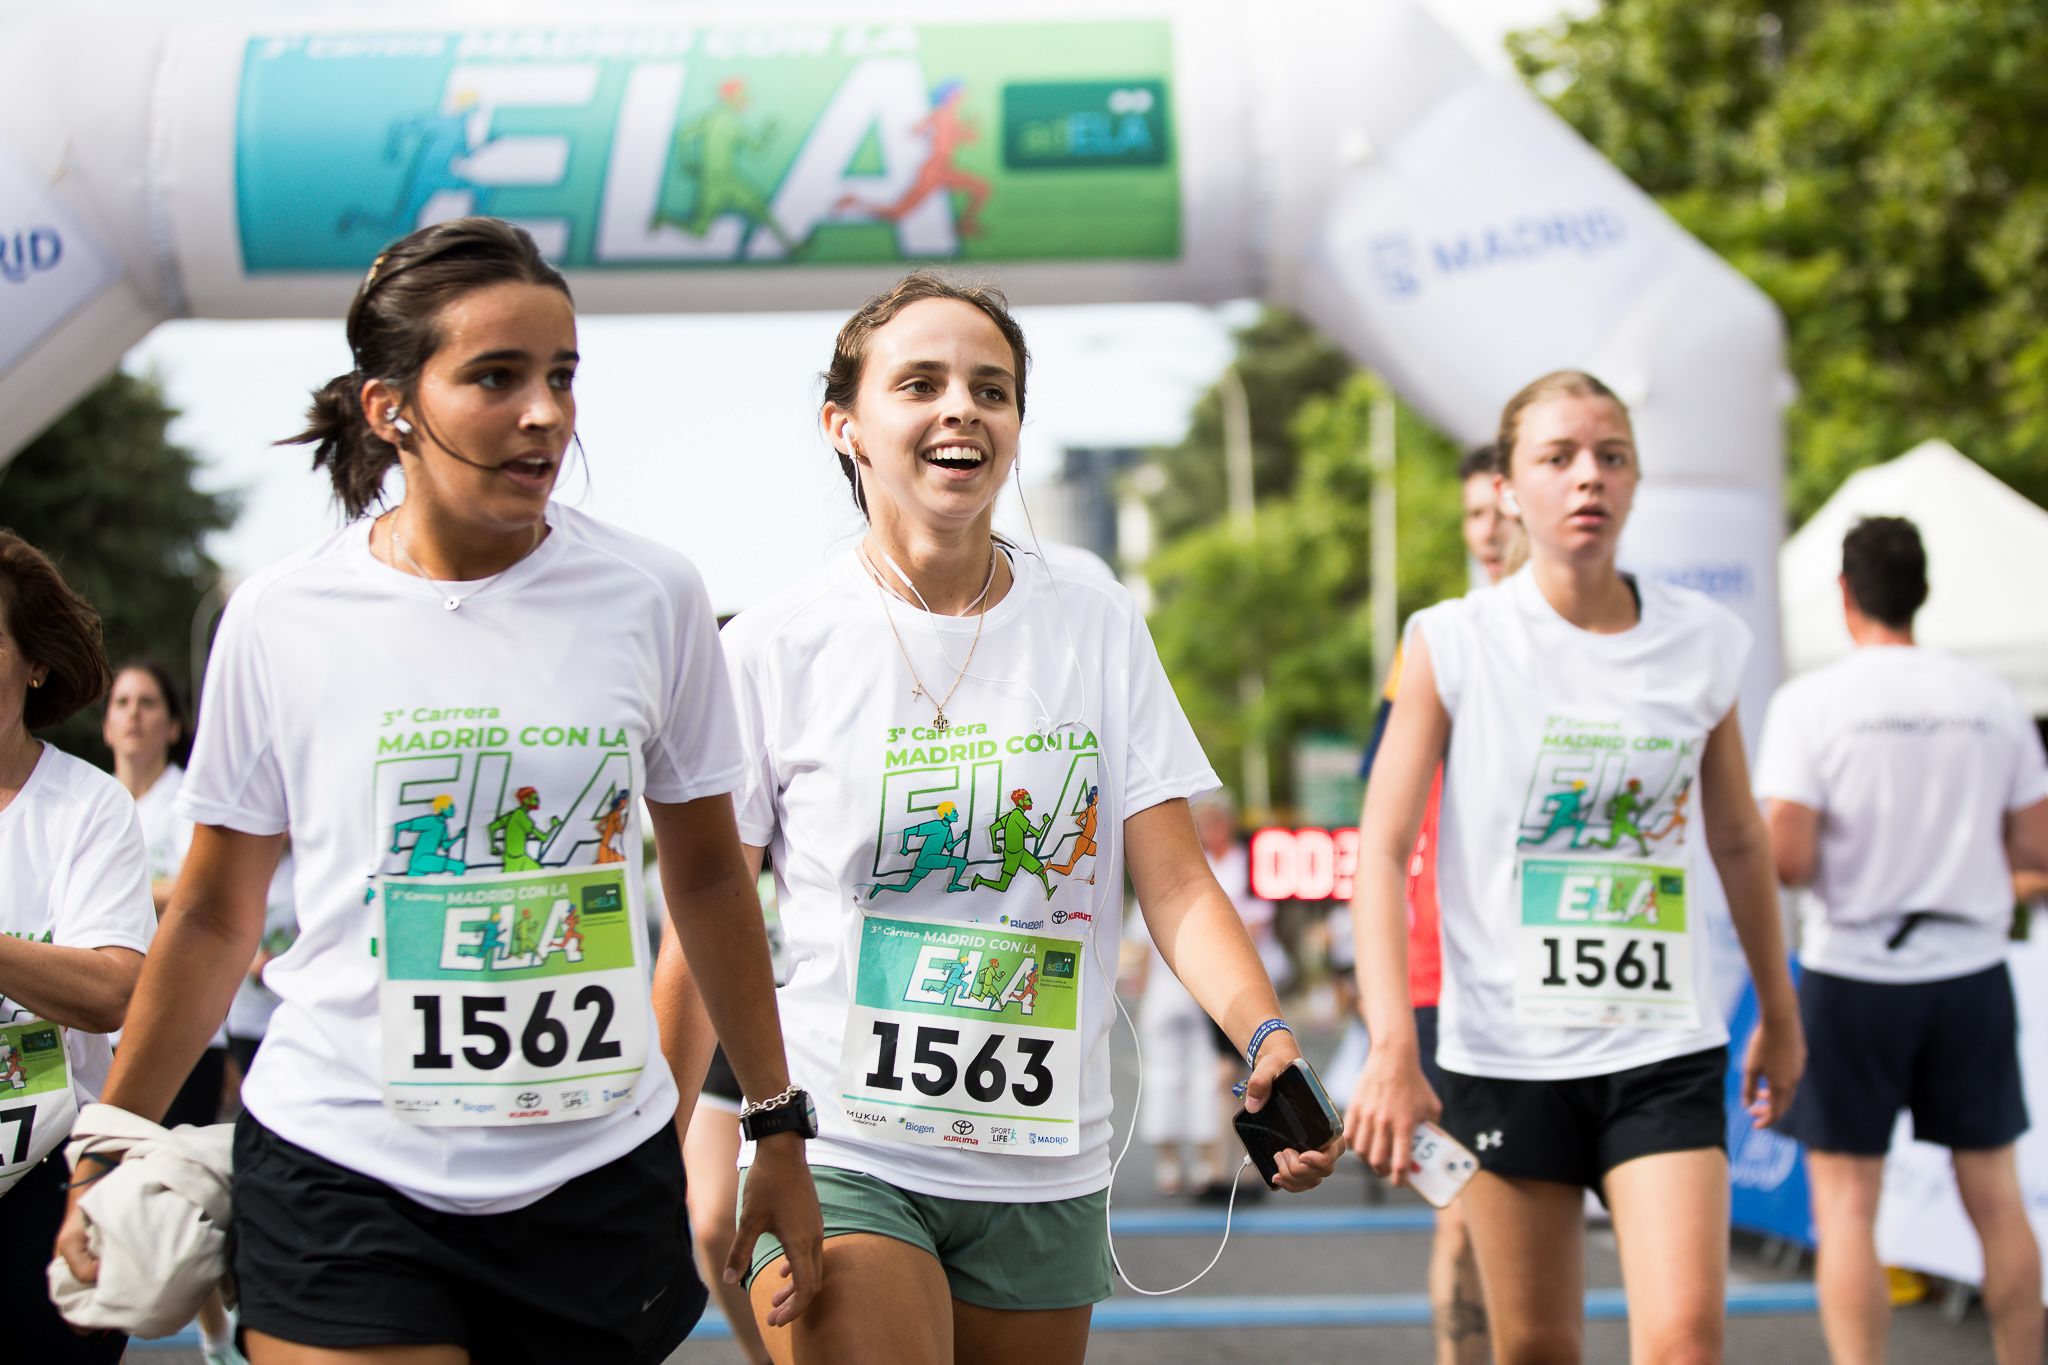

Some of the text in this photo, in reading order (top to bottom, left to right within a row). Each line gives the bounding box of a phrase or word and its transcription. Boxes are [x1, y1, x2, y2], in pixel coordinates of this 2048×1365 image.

[415, 58, 962, 262] ELA
[412, 706, 500, 724] Carrera
[378, 726, 629, 755] MADRID CON LA
[886, 722, 988, 744] 3ª Carrera
[1542, 734, 1626, 751] MADRID
[1632, 736, 1674, 752] CON
[885, 740, 998, 769] MADRID
[1069, 730, 1099, 750] LA
[447, 888, 516, 905] MADRID
[518, 885, 546, 900] CON
[551, 882, 570, 897] LA
[1555, 874, 1660, 925] ELA
[439, 898, 585, 971] ELA
[883, 926, 920, 940] Carrera
[923, 930, 986, 949] MADRID
[989, 938, 1022, 953] CON
[1022, 943, 1037, 955] LA
[1542, 938, 1672, 991] 1561
[902, 944, 1037, 1017] ELA
[412, 985, 622, 1070] 1562
[865, 1020, 1055, 1107] 1563
[846, 1110, 887, 1123] MUKUA
[905, 1121, 935, 1134] Biogen
[990, 1126, 1011, 1135] SPORT
[0, 1104, 37, 1164] 7
[993, 1134, 1008, 1143] LIFE
[1037, 1136, 1069, 1145] MADRID
